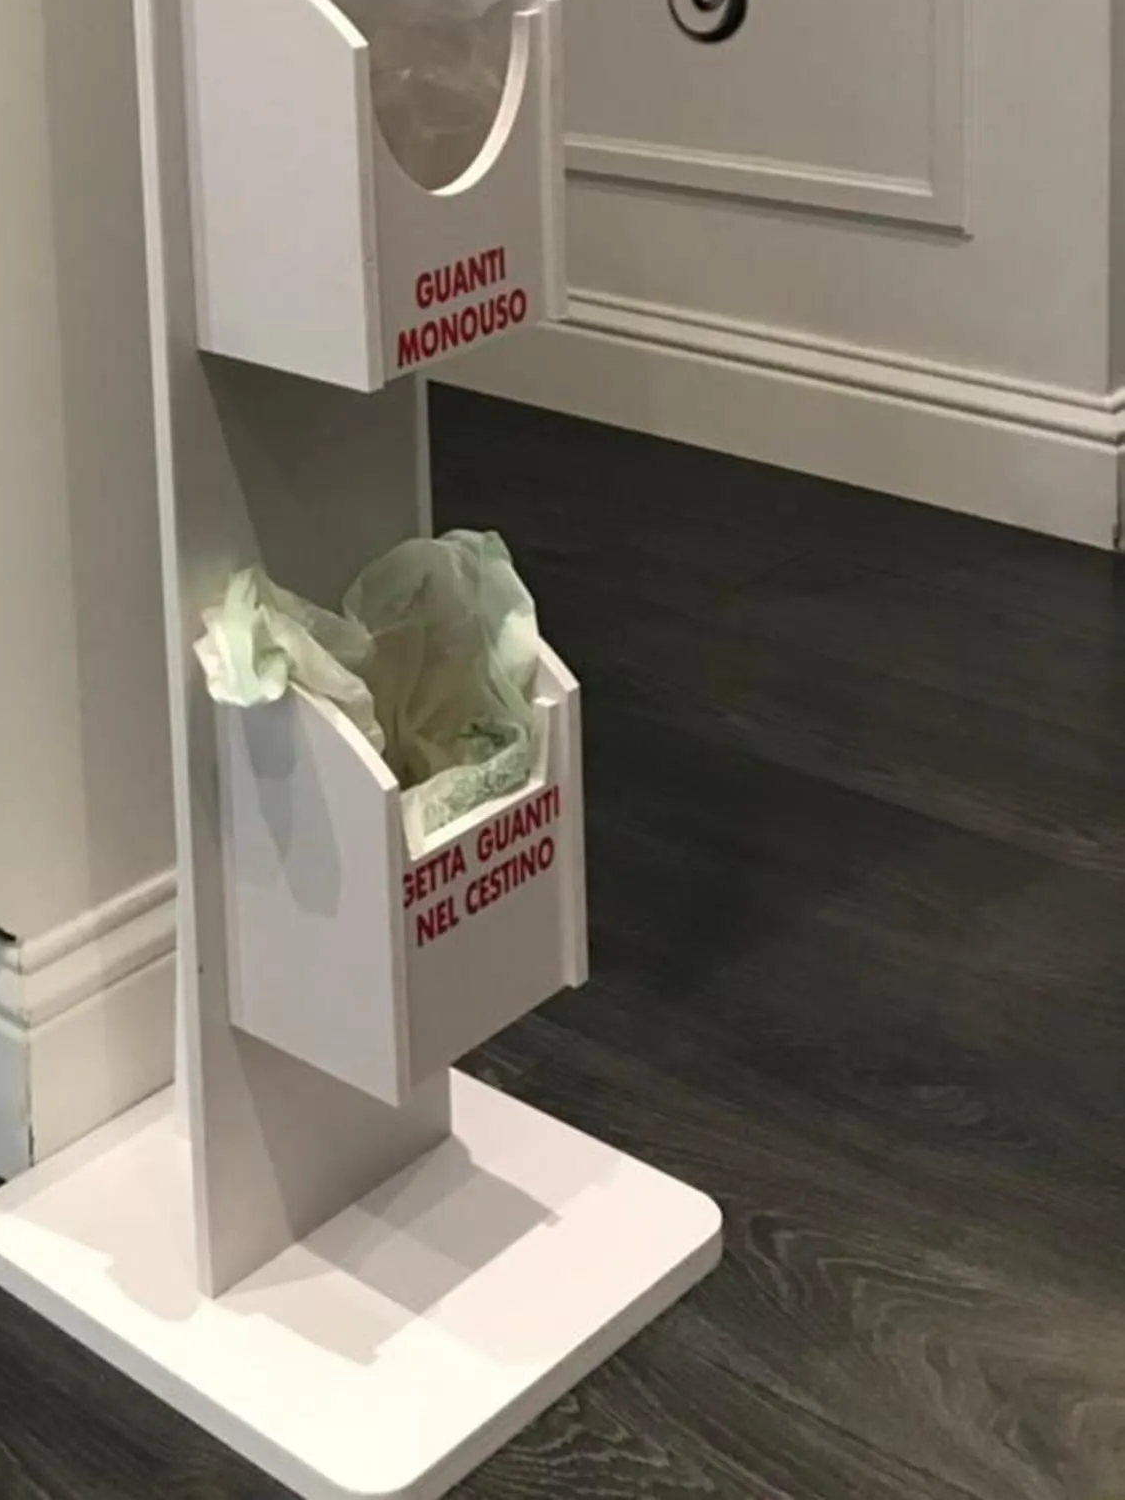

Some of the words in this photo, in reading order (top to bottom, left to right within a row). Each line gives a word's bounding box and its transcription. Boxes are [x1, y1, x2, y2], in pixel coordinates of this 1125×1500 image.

[416, 246, 505, 309] GUANTI
[397, 288, 527, 369] MONOUSO
[477, 785, 560, 862] GUANTI
[416, 895, 459, 948] NEL
[465, 836, 555, 915] CESTINO
